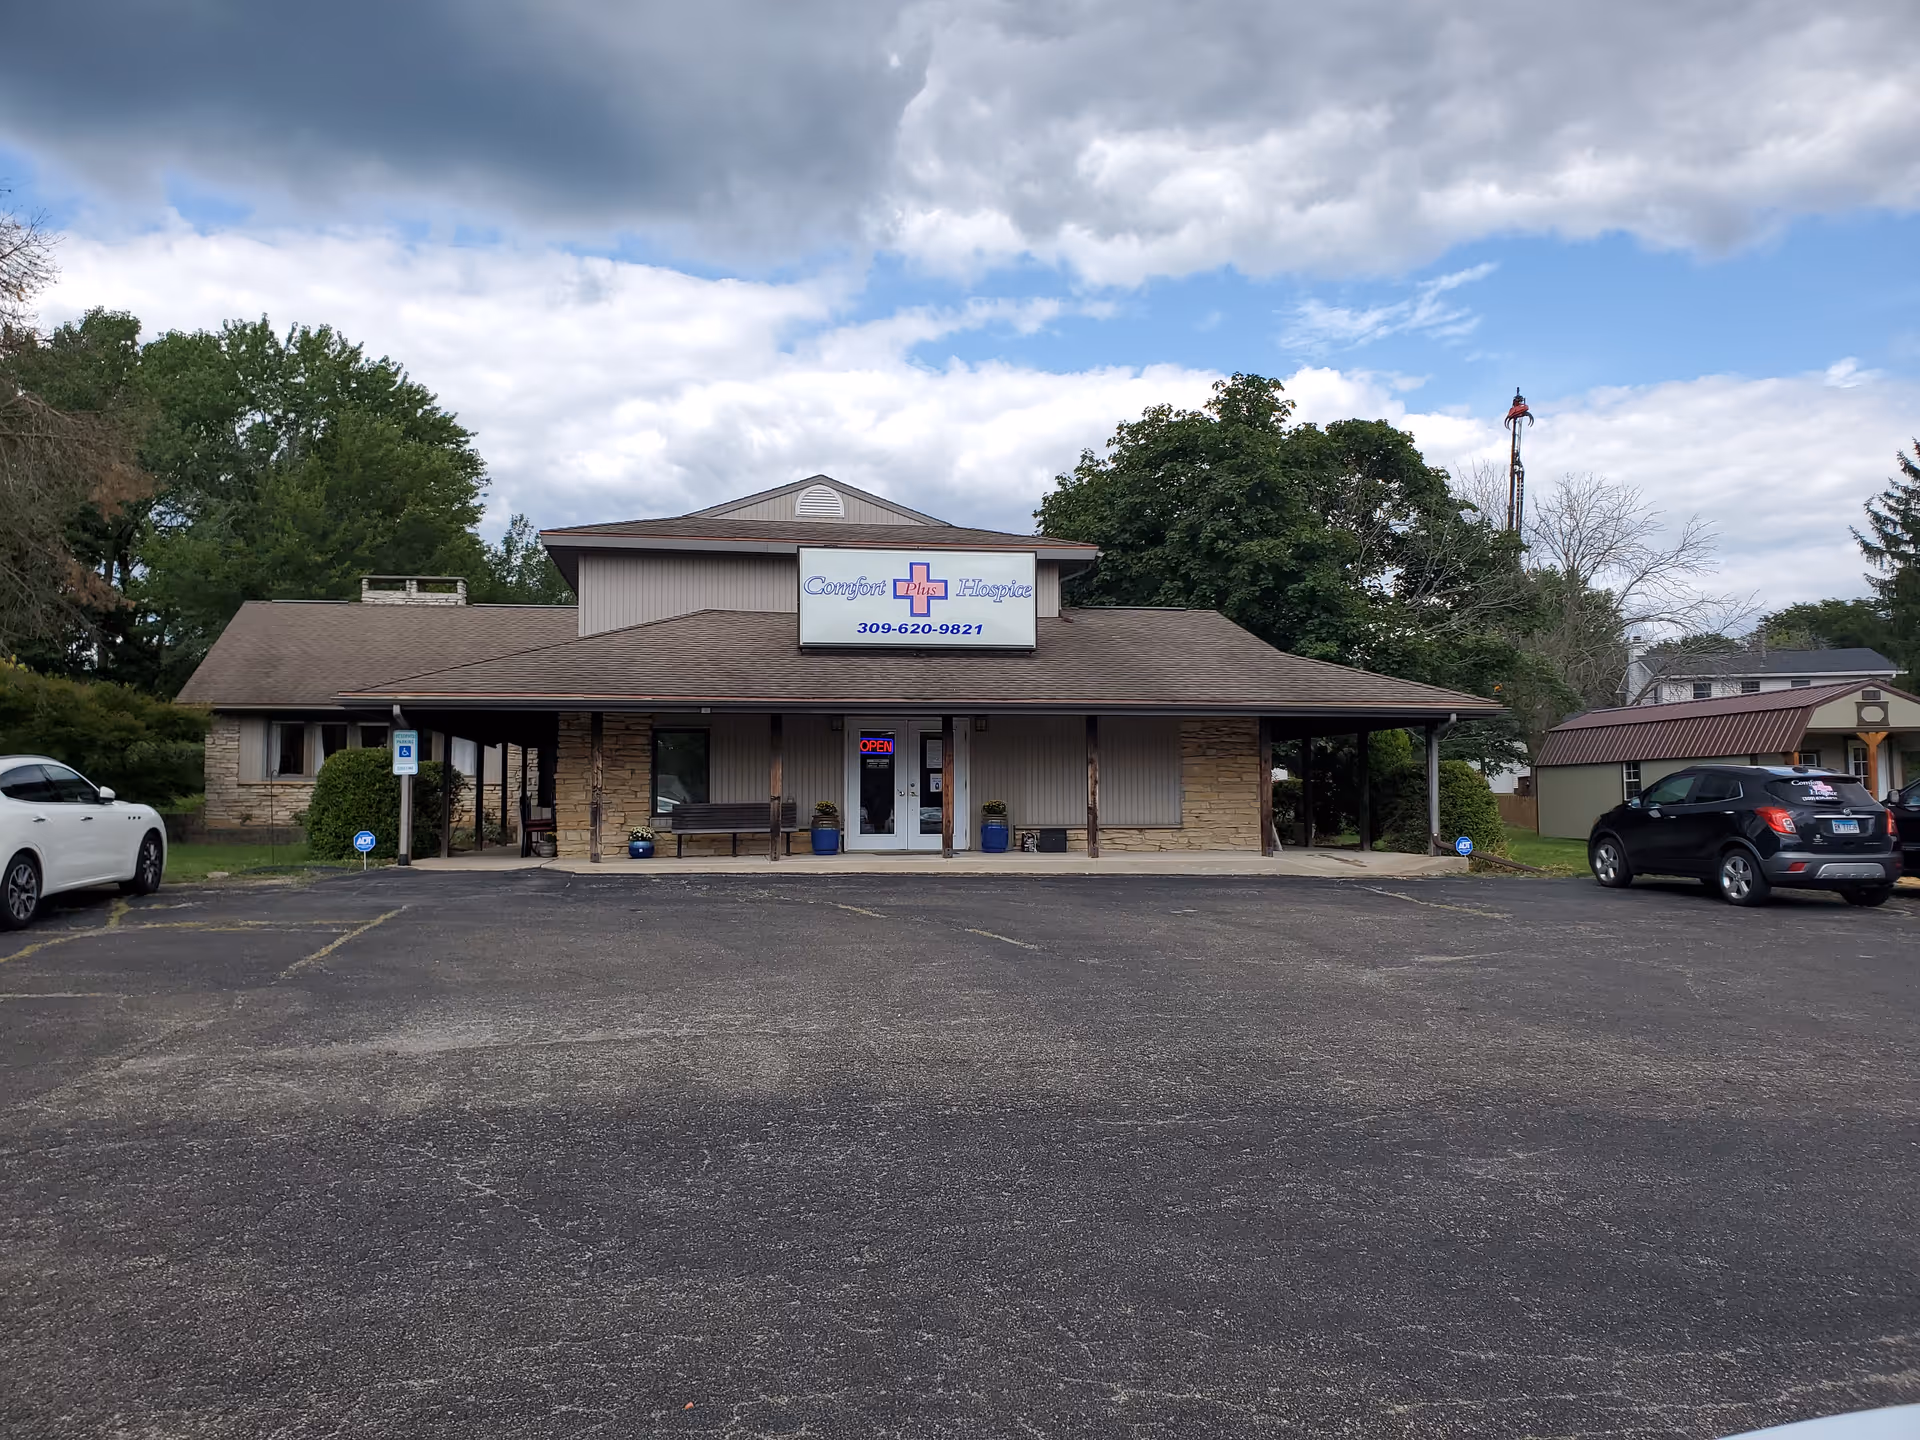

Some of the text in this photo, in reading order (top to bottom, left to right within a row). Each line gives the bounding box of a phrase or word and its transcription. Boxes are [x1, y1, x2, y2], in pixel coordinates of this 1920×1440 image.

[803, 575, 1033, 603] Comfort Plus Hospice
[856, 622, 983, 636] 309-620-9821
[860, 740, 892, 752] OPEN
[356, 836, 373, 845] ADT
[1458, 841, 1471, 849] ADT
